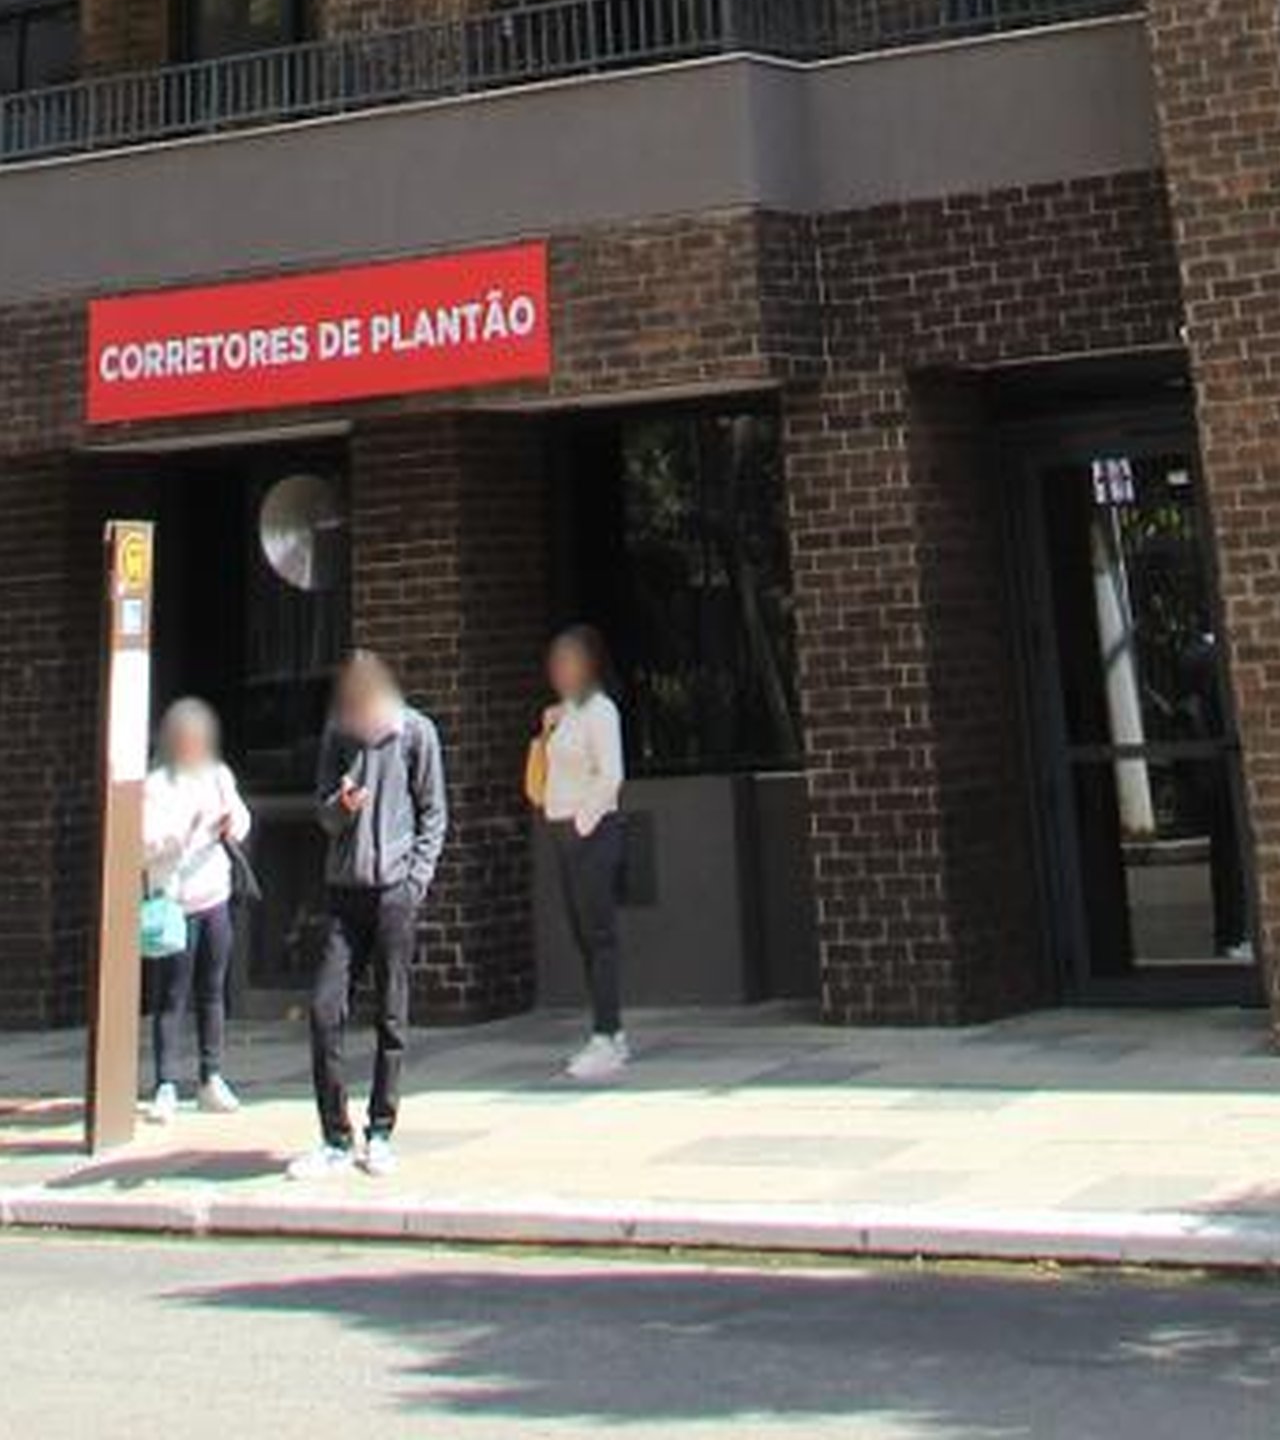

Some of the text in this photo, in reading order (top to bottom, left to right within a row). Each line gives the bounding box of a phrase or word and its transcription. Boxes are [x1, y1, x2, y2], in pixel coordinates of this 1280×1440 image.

[99, 290, 536, 381] CORRETORES DE PLANTÃO
